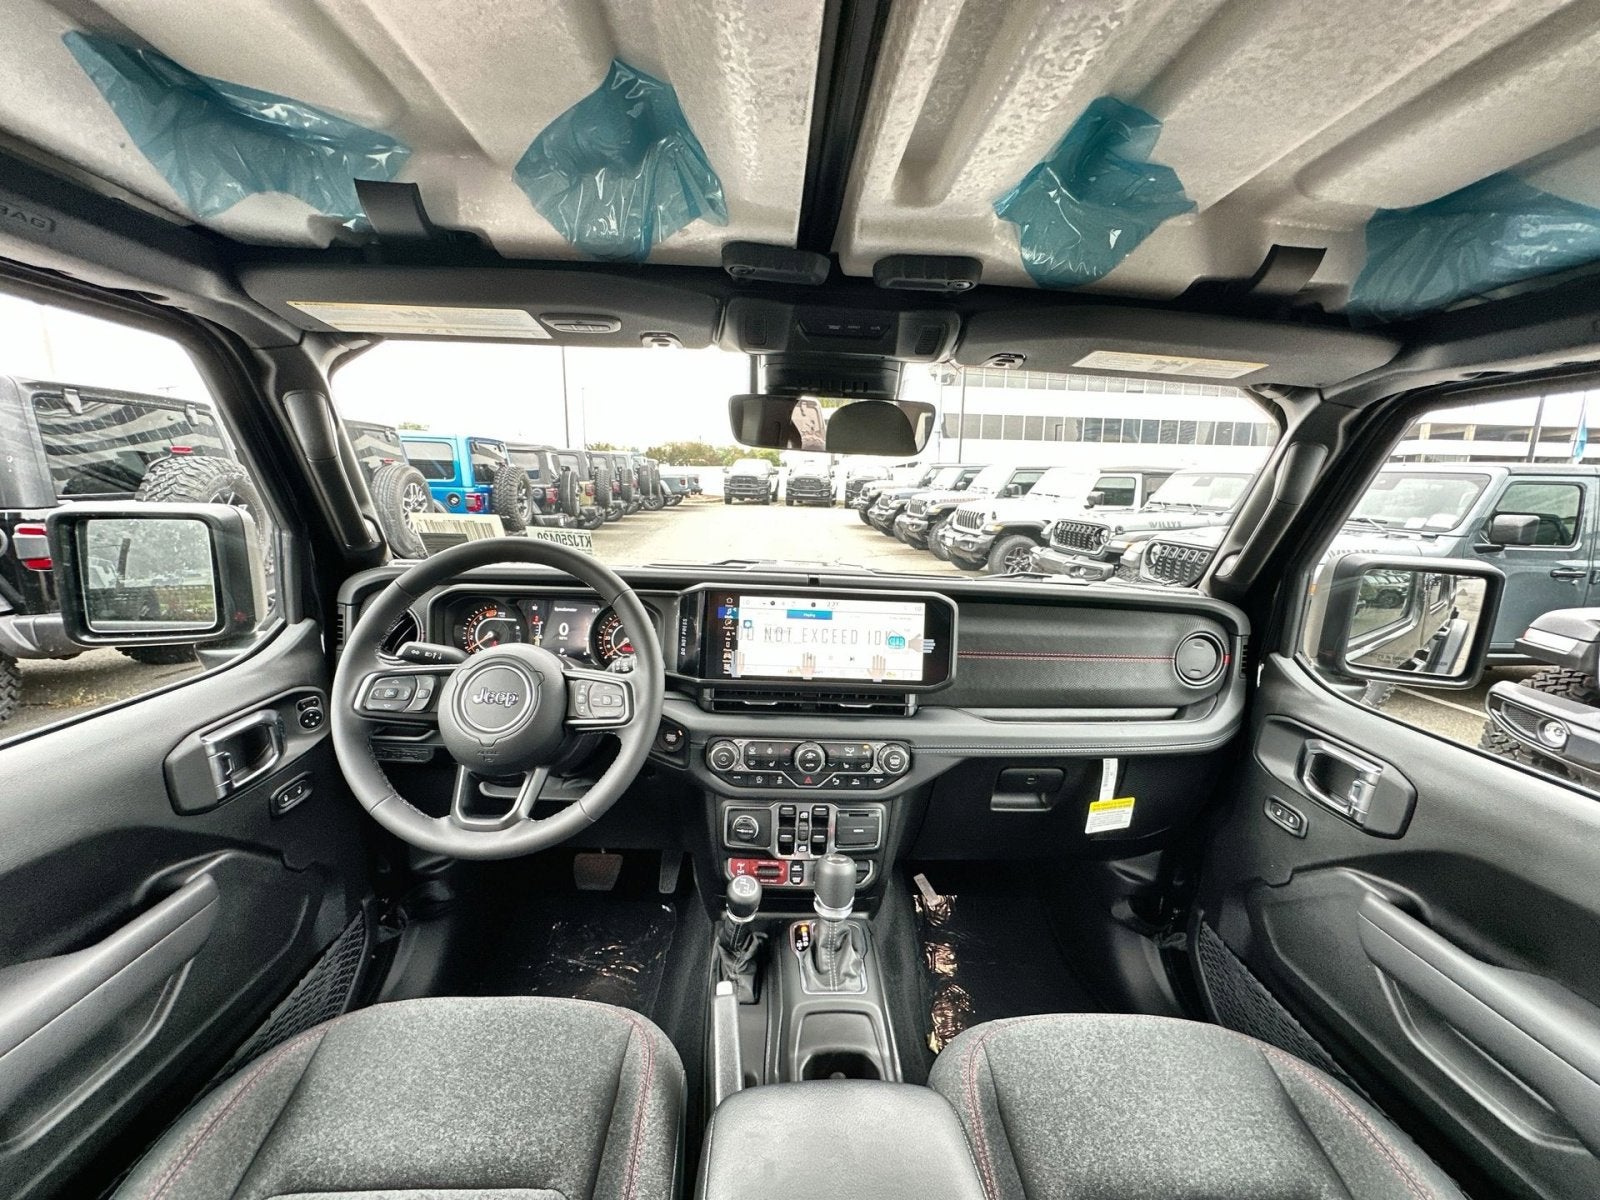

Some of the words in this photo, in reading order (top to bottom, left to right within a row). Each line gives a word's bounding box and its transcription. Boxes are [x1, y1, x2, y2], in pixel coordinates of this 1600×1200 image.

[764, 626, 792, 643] NOT
[802, 627, 858, 645] EXCEED
[472, 687, 519, 708] Jeep
